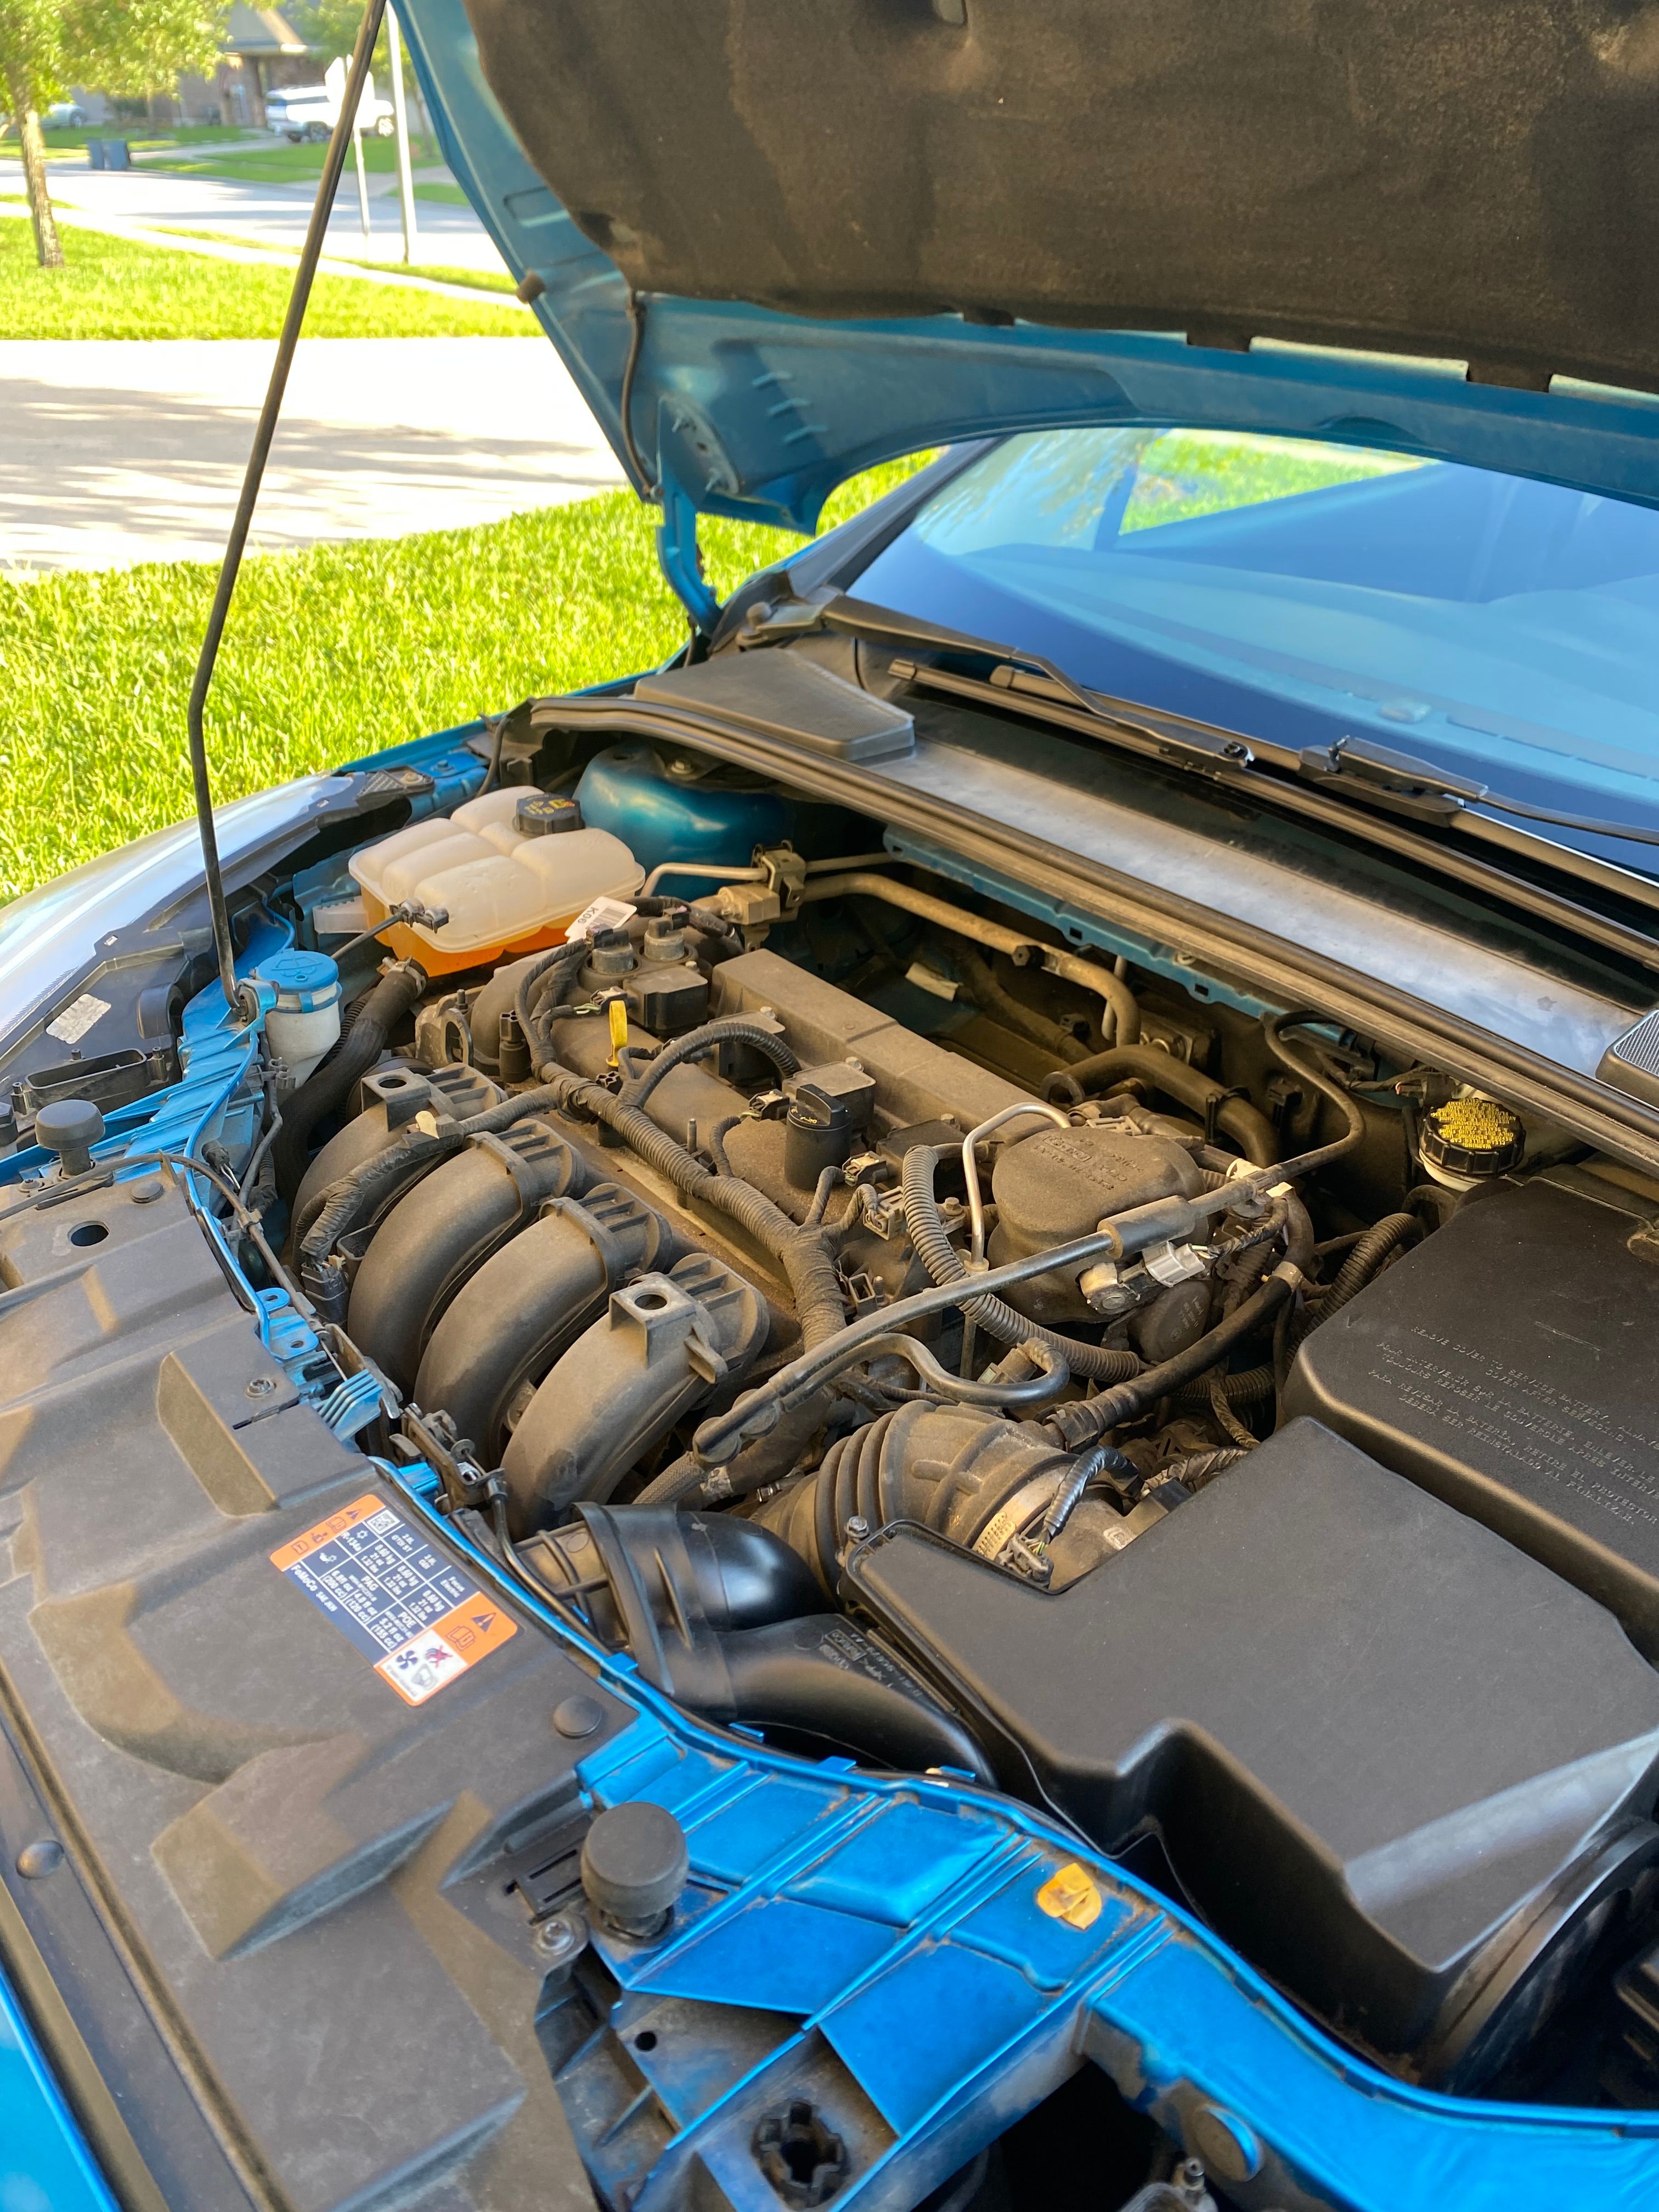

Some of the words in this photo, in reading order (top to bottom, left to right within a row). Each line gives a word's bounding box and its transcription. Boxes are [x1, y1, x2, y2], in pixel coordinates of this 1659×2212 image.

[578, 907, 599, 924] K06
[1453, 1344, 1485, 1361] COVER
[1491, 1360, 1503, 1369] TO
[1508, 1369, 1555, 1394] SERVICE
[1485, 1369, 1519, 1387] COVER
[1522, 1389, 1557, 1406] AFTER
[1376, 1342, 1403, 1356] POUR
[1473, 1385, 1494, 1399] SUR
[1498, 1397, 1511, 1408] LA
[1639, 1471, 1655, 1483] LE
[1434, 1378, 1481, 1402] REPOSER
[1485, 1402, 1500, 1412] LE
[1504, 1411, 1565, 1445] COUVERCLE
[1368, 1370, 1392, 1384] PARA
[1398, 1383, 1443, 1407] REVISAR
[1447, 1406, 1460, 1416] LA
[1523, 1446, 1567, 1470] RETIRE
[1571, 1469, 1584, 1482] EL
[1592, 1483, 1657, 1524] PROTECTOR
[1442, 1415, 1463, 1429] SER
[1467, 1428, 1541, 1469] REINSTALADO
[1545, 1470, 1560, 1481] AL
[341, 1531, 362, 1551] R-134a
[374, 1544, 390, 1556] 0.60
[385, 1554, 396, 1565] kg
[291, 1564, 318, 1591] FoMoCo
[321, 1575, 338, 1589] (200
[334, 1588, 348, 1599] cc)
[343, 1583, 353, 1592] oz
[360, 1575, 379, 1590] PAG
[408, 1575, 419, 1586] kg
[343, 1598, 362, 1612] (120
[355, 1611, 371, 1623] cc)
[354, 1593, 366, 1603] 4.0
[367, 1607, 377, 1615] oz
[433, 1600, 444, 1611] kg
[379, 1617, 392, 1629] 5.2
[393, 1633, 404, 1642] oz
[397, 1611, 416, 1628] POE
[368, 1624, 388, 1640] (155
[381, 1637, 398, 1650] cc)
